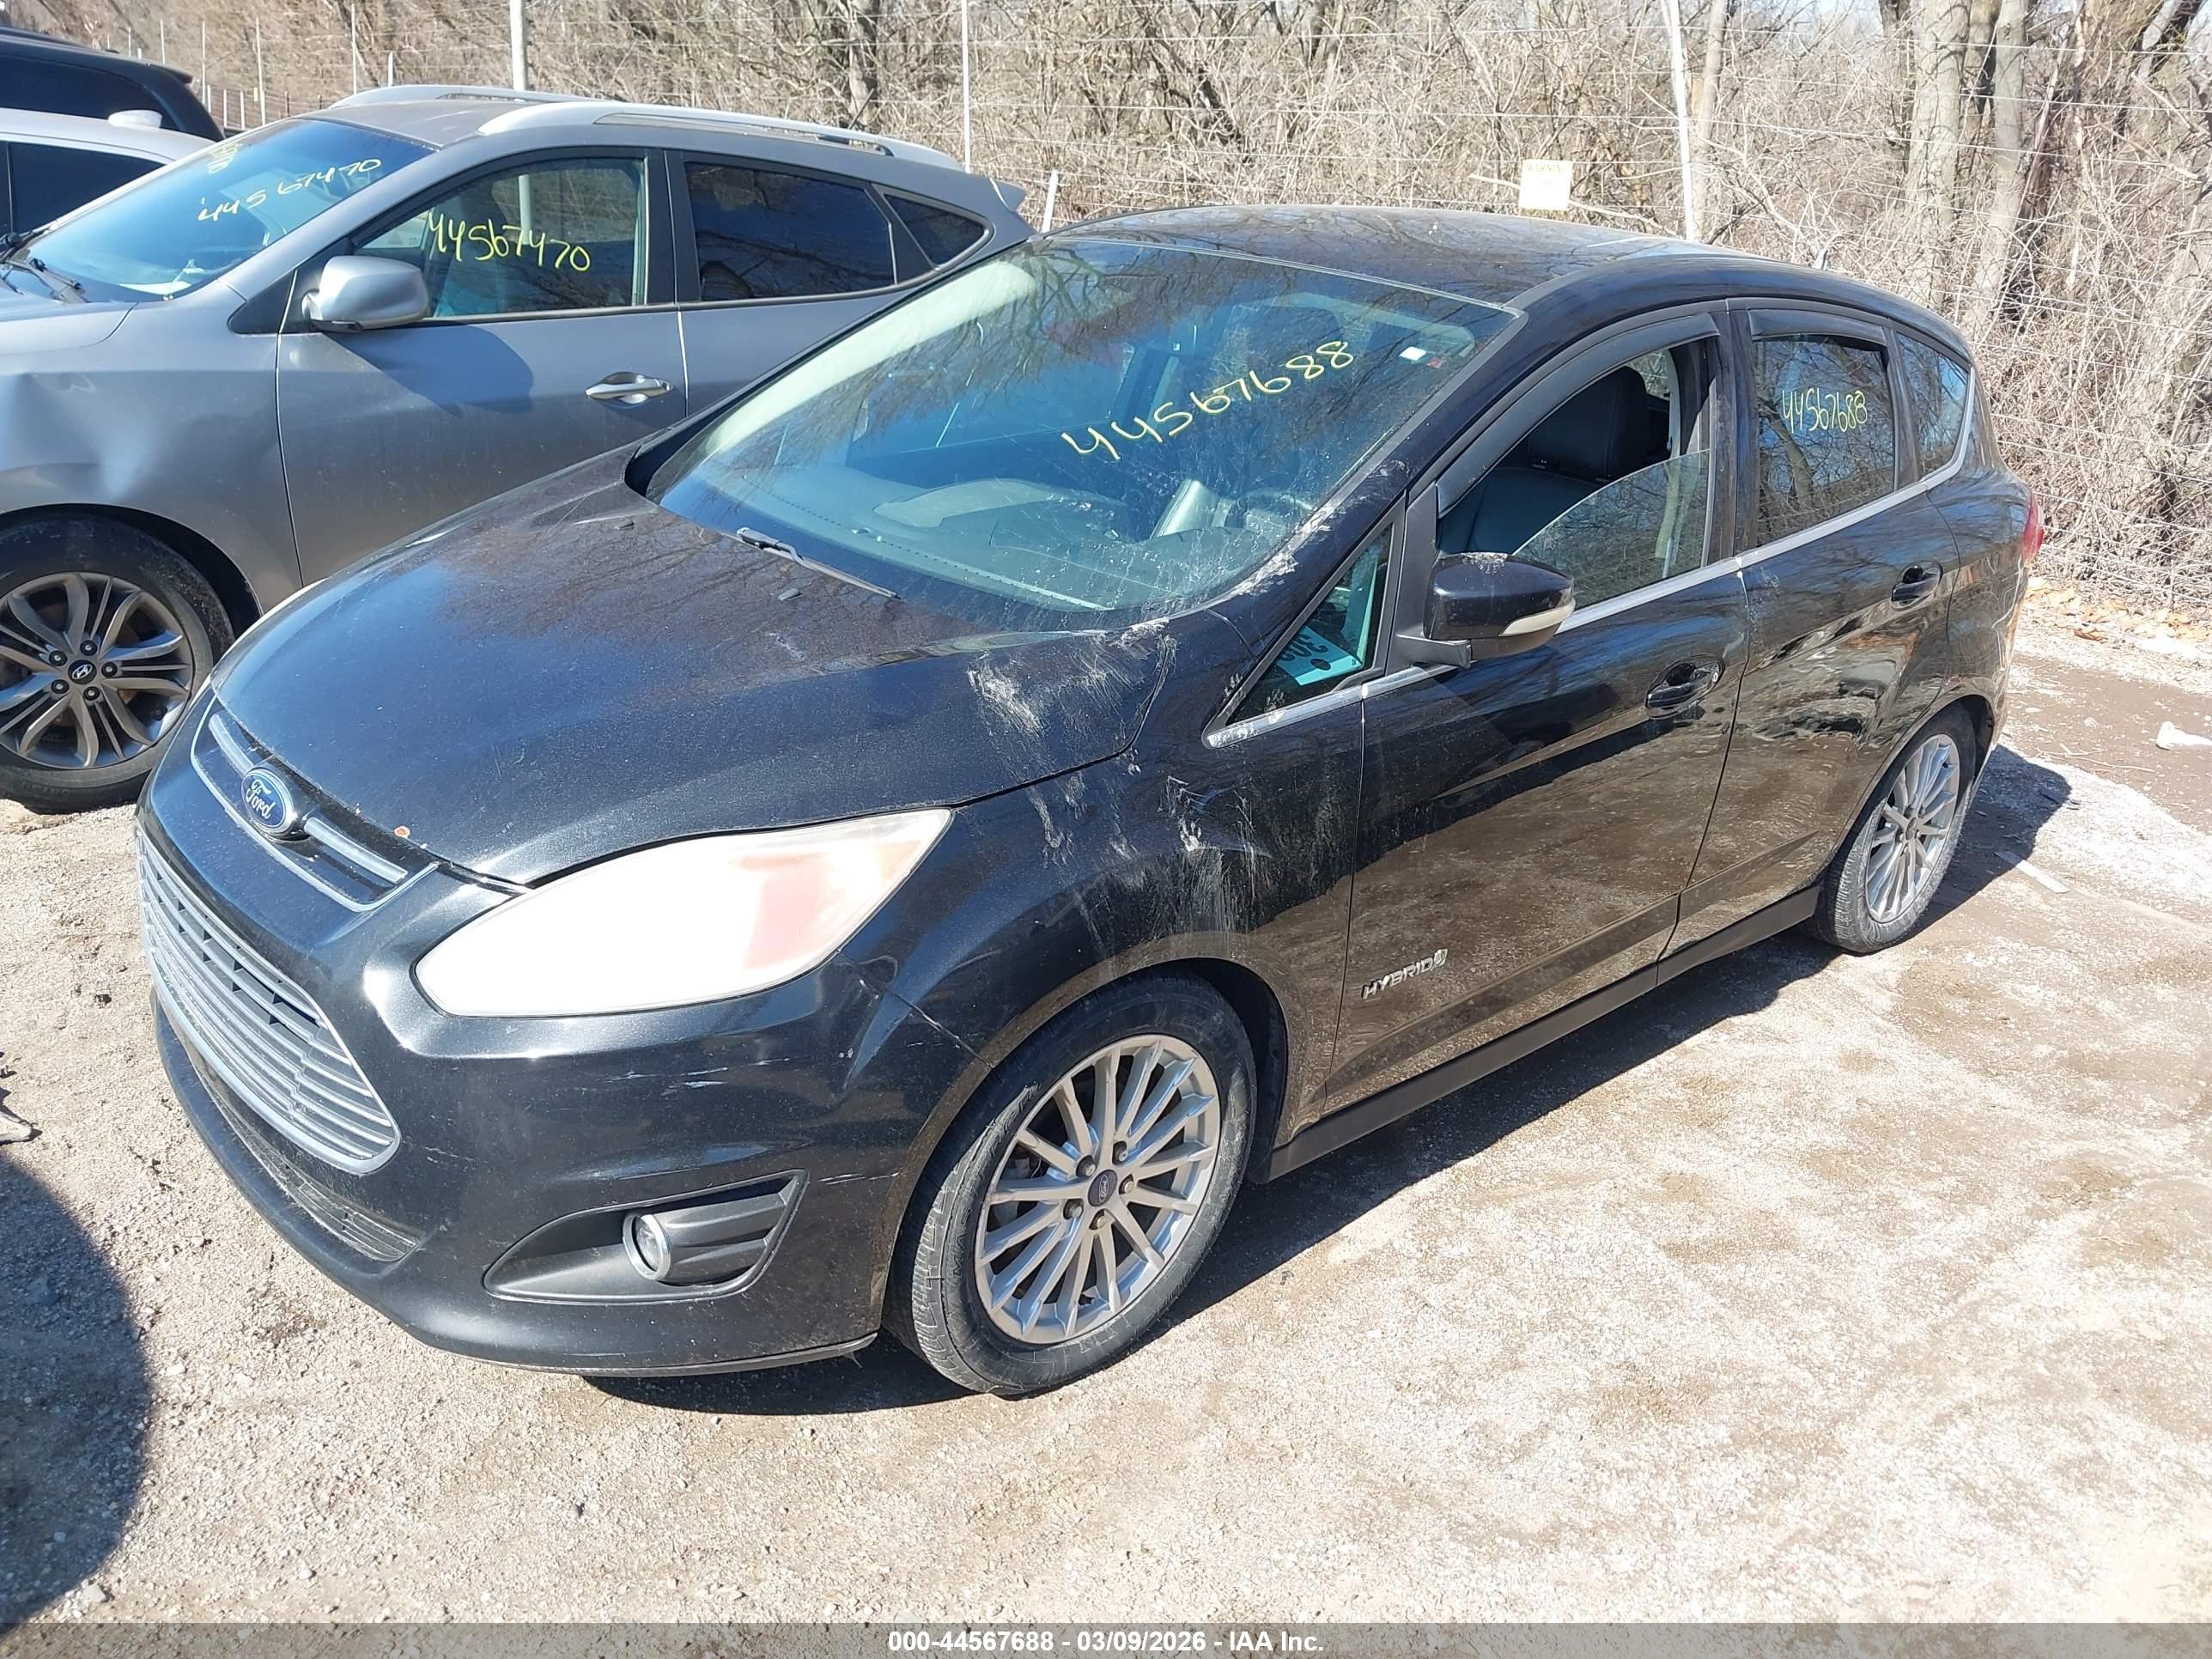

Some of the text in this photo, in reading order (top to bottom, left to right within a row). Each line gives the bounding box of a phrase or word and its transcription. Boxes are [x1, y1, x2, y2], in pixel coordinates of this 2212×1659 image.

[198, 158, 382, 222] 44567470
[428, 211, 591, 271] 44567470
[1060, 340, 1354, 461] 44567688
[1782, 387, 1868, 434] 44567688
[245, 778, 276, 820] Ford
[1361, 957, 1435, 1000] HYBRID
